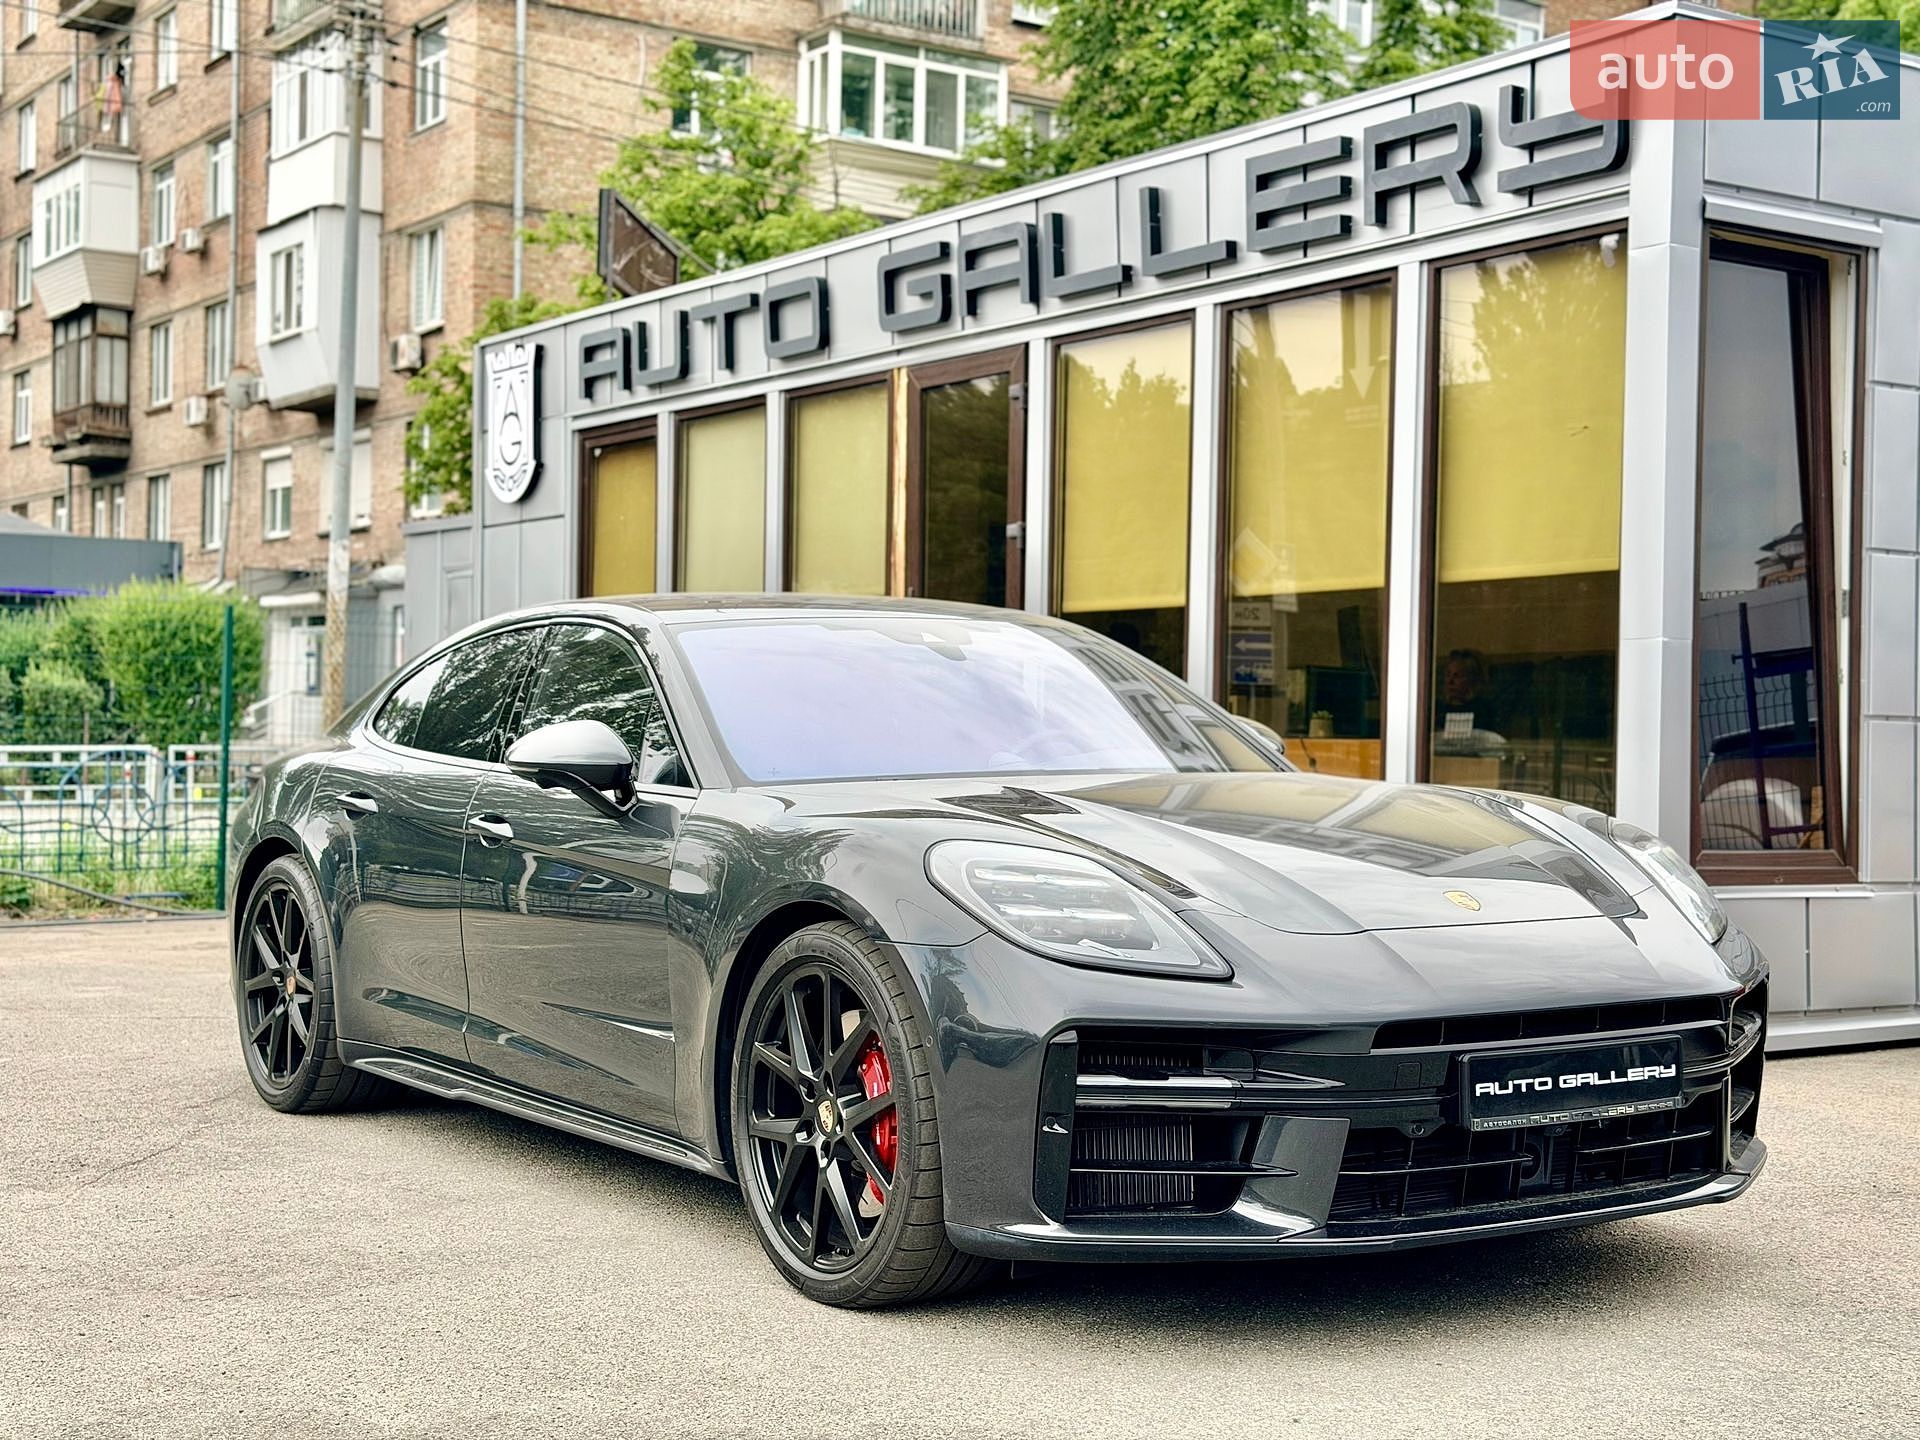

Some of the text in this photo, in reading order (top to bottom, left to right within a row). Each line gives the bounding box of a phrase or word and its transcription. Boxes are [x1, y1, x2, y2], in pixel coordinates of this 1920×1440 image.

[578, 55, 1630, 399] AUTO GALLERY
[1475, 1064, 1677, 1097] AUTO GALLERY
[1530, 1112, 1570, 1124] AUTO
